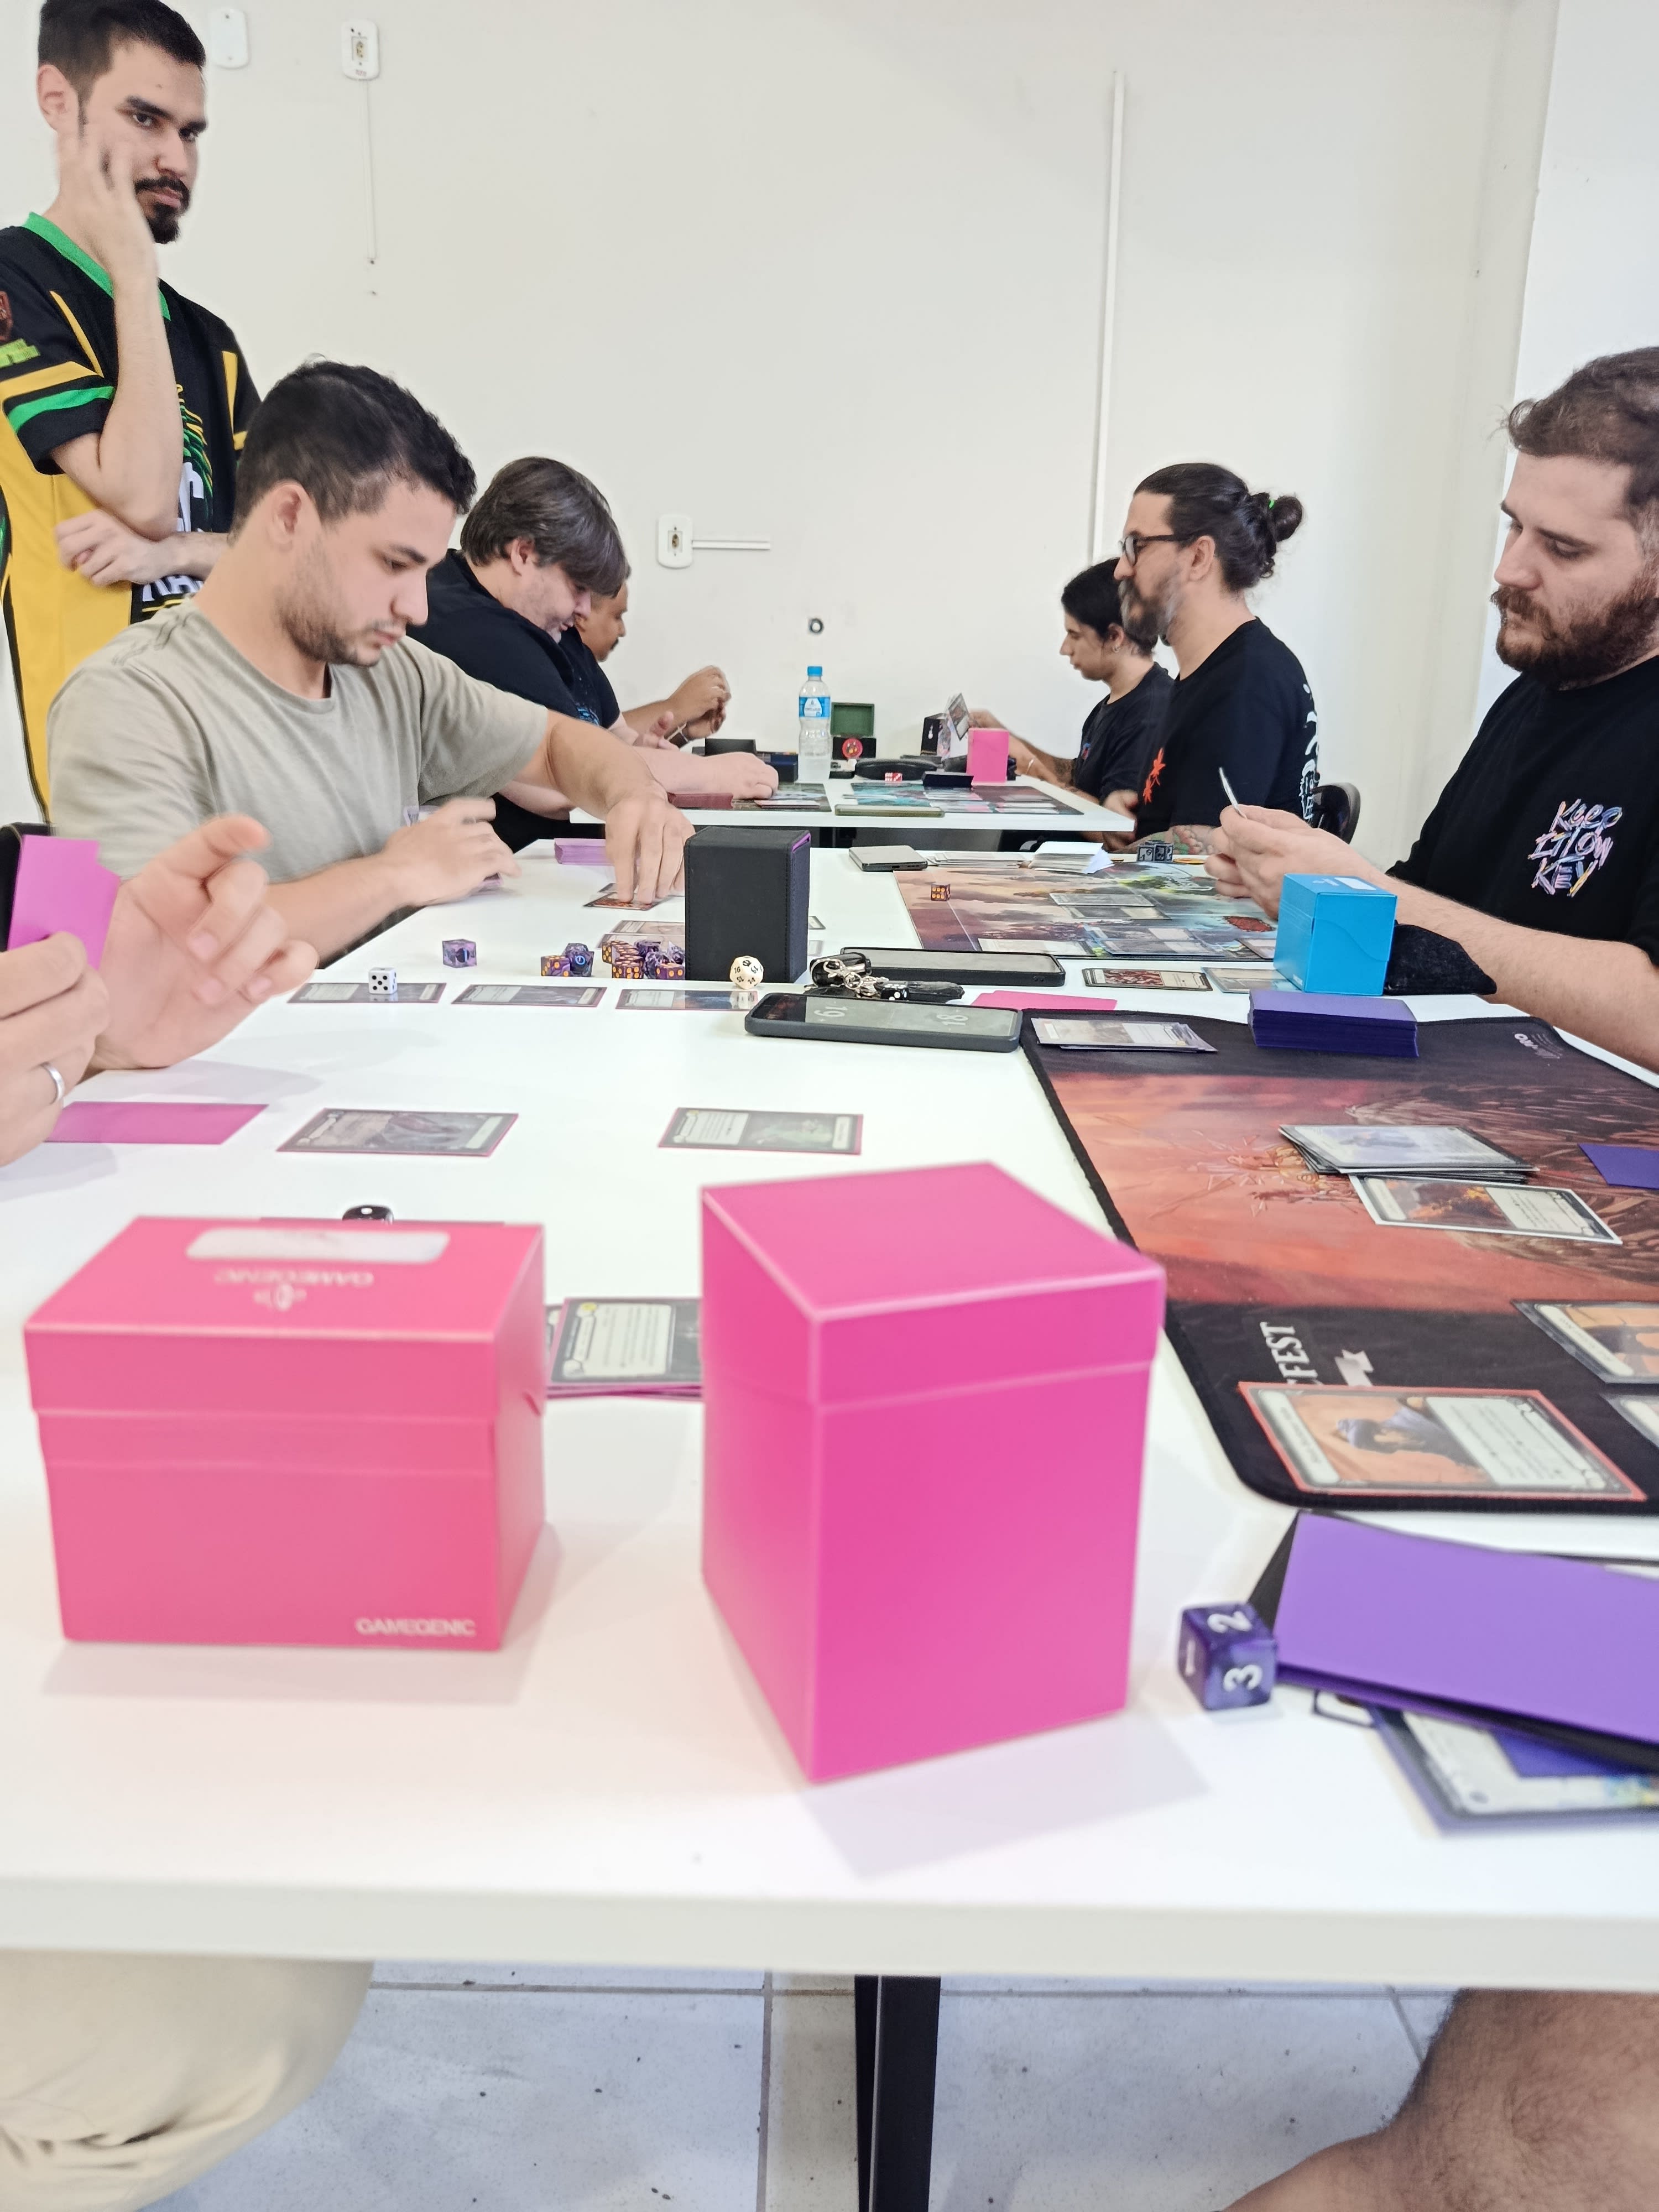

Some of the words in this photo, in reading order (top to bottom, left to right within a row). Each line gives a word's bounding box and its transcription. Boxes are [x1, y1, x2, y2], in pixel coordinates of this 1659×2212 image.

[1531, 858, 1598, 898] KEY
[813, 1006, 848, 1018] 19
[936, 1014, 969, 1026] 18
[356, 1618, 476, 1636] GAMEGENIC
[1207, 1610, 1253, 1633] 2
[1223, 1664, 1264, 1692] 3
